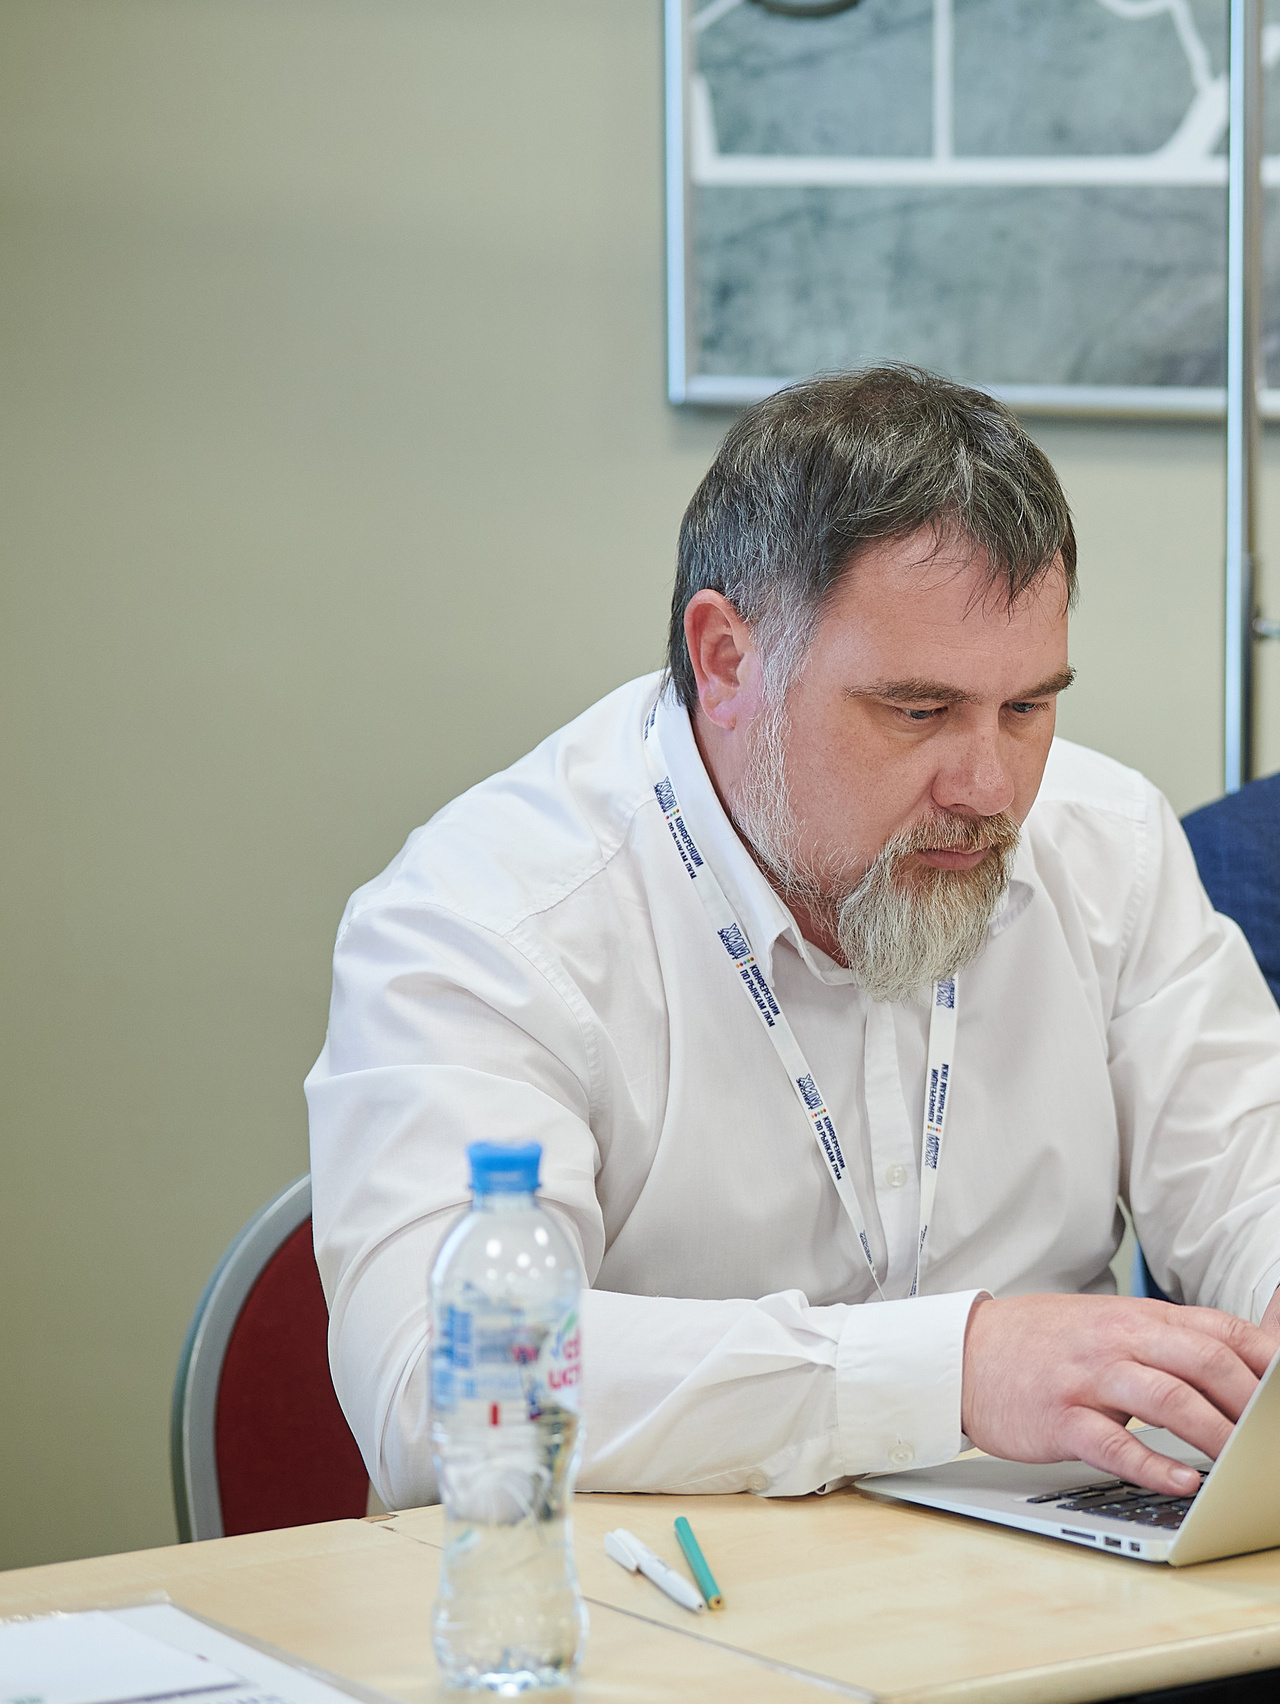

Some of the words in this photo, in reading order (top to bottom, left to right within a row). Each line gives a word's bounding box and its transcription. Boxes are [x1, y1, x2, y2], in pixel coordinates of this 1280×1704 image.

[657, 776, 678, 811] ХИМ
[674, 815, 704, 867] КОНФЕРЕНЦИИ
[717, 930, 739, 960] ЭКСПЕРТ
[722, 923, 751, 959] ХИМ
[740, 969, 750, 980] ПО
[745, 979, 767, 1011] РЫНКАМ
[762, 1010, 775, 1027] ЛКМ
[749, 964, 780, 1016] КОНФЕРЕНЦИИ
[799, 1073, 823, 1109] ХИМ
[928, 1068, 939, 1123] КОНФЕРЕНЦИИ
[937, 1082, 947, 1114] РЫНКАМ
[936, 1114, 943, 1126] ПО
[814, 1120, 823, 1132] ПО
[819, 1130, 836, 1163] РЫНКАМ
[831, 1163, 842, 1180] ЛКМ
[822, 1116, 846, 1169] КОНФЕРЕНЦИИ
[924, 1132, 937, 1169] ХИМ
